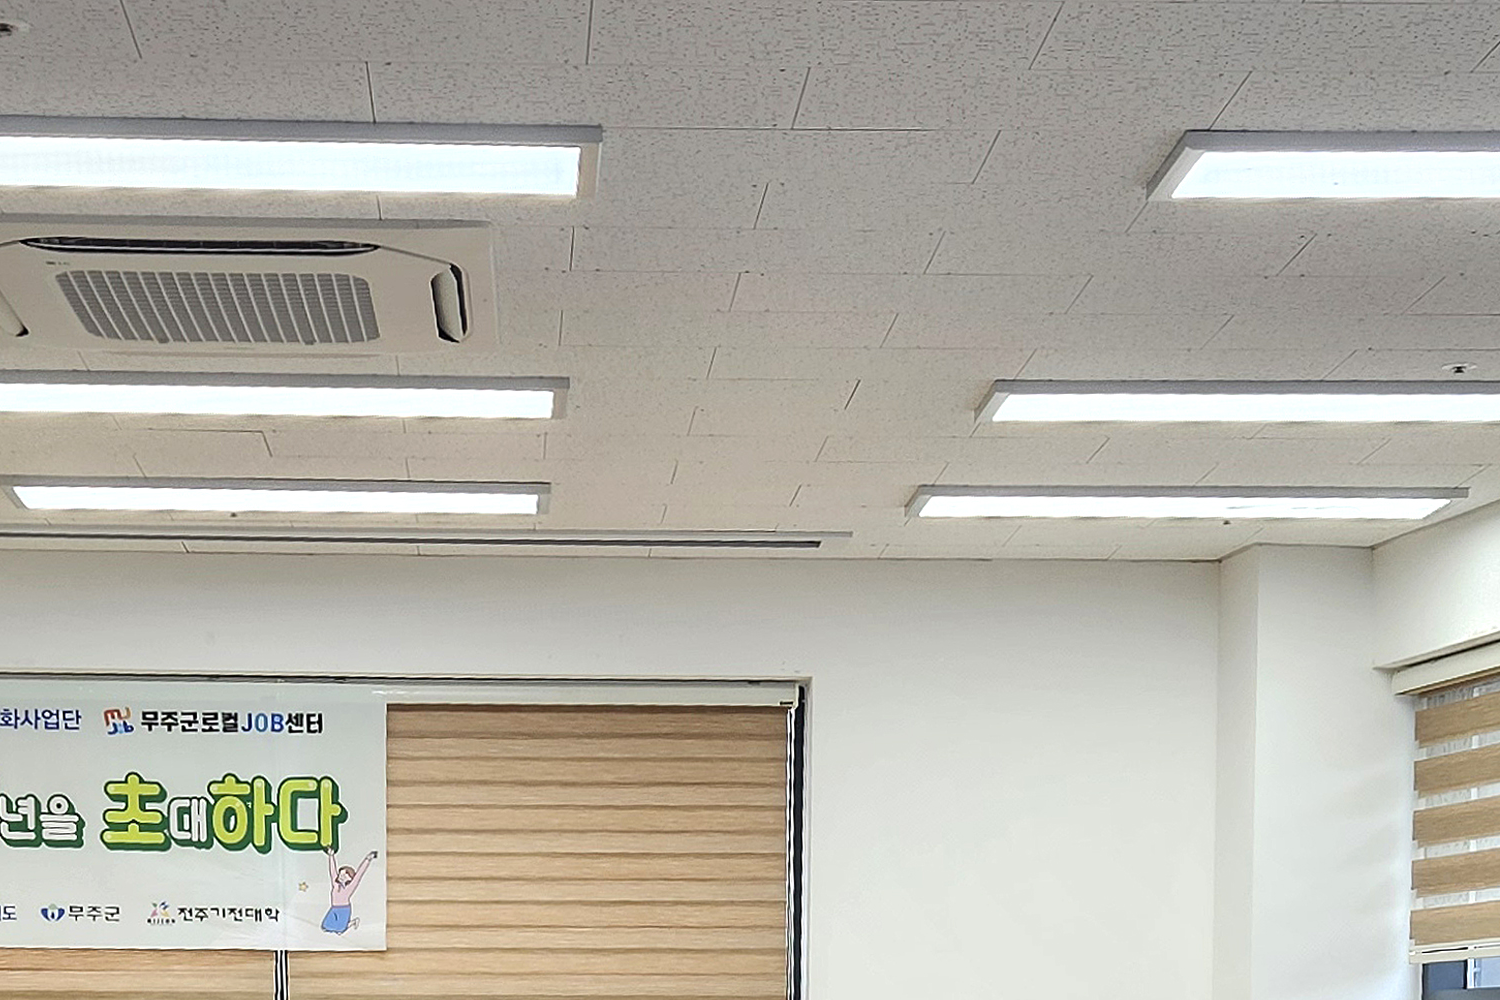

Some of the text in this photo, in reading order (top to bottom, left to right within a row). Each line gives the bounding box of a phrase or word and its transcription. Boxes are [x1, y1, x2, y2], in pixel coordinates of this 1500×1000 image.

[141, 711, 323, 734] 무주군로컬JOB센터
[100, 771, 348, 854] 초대하다
[68, 904, 120, 922] 무주군
[177, 907, 281, 923] 전주기전대학
